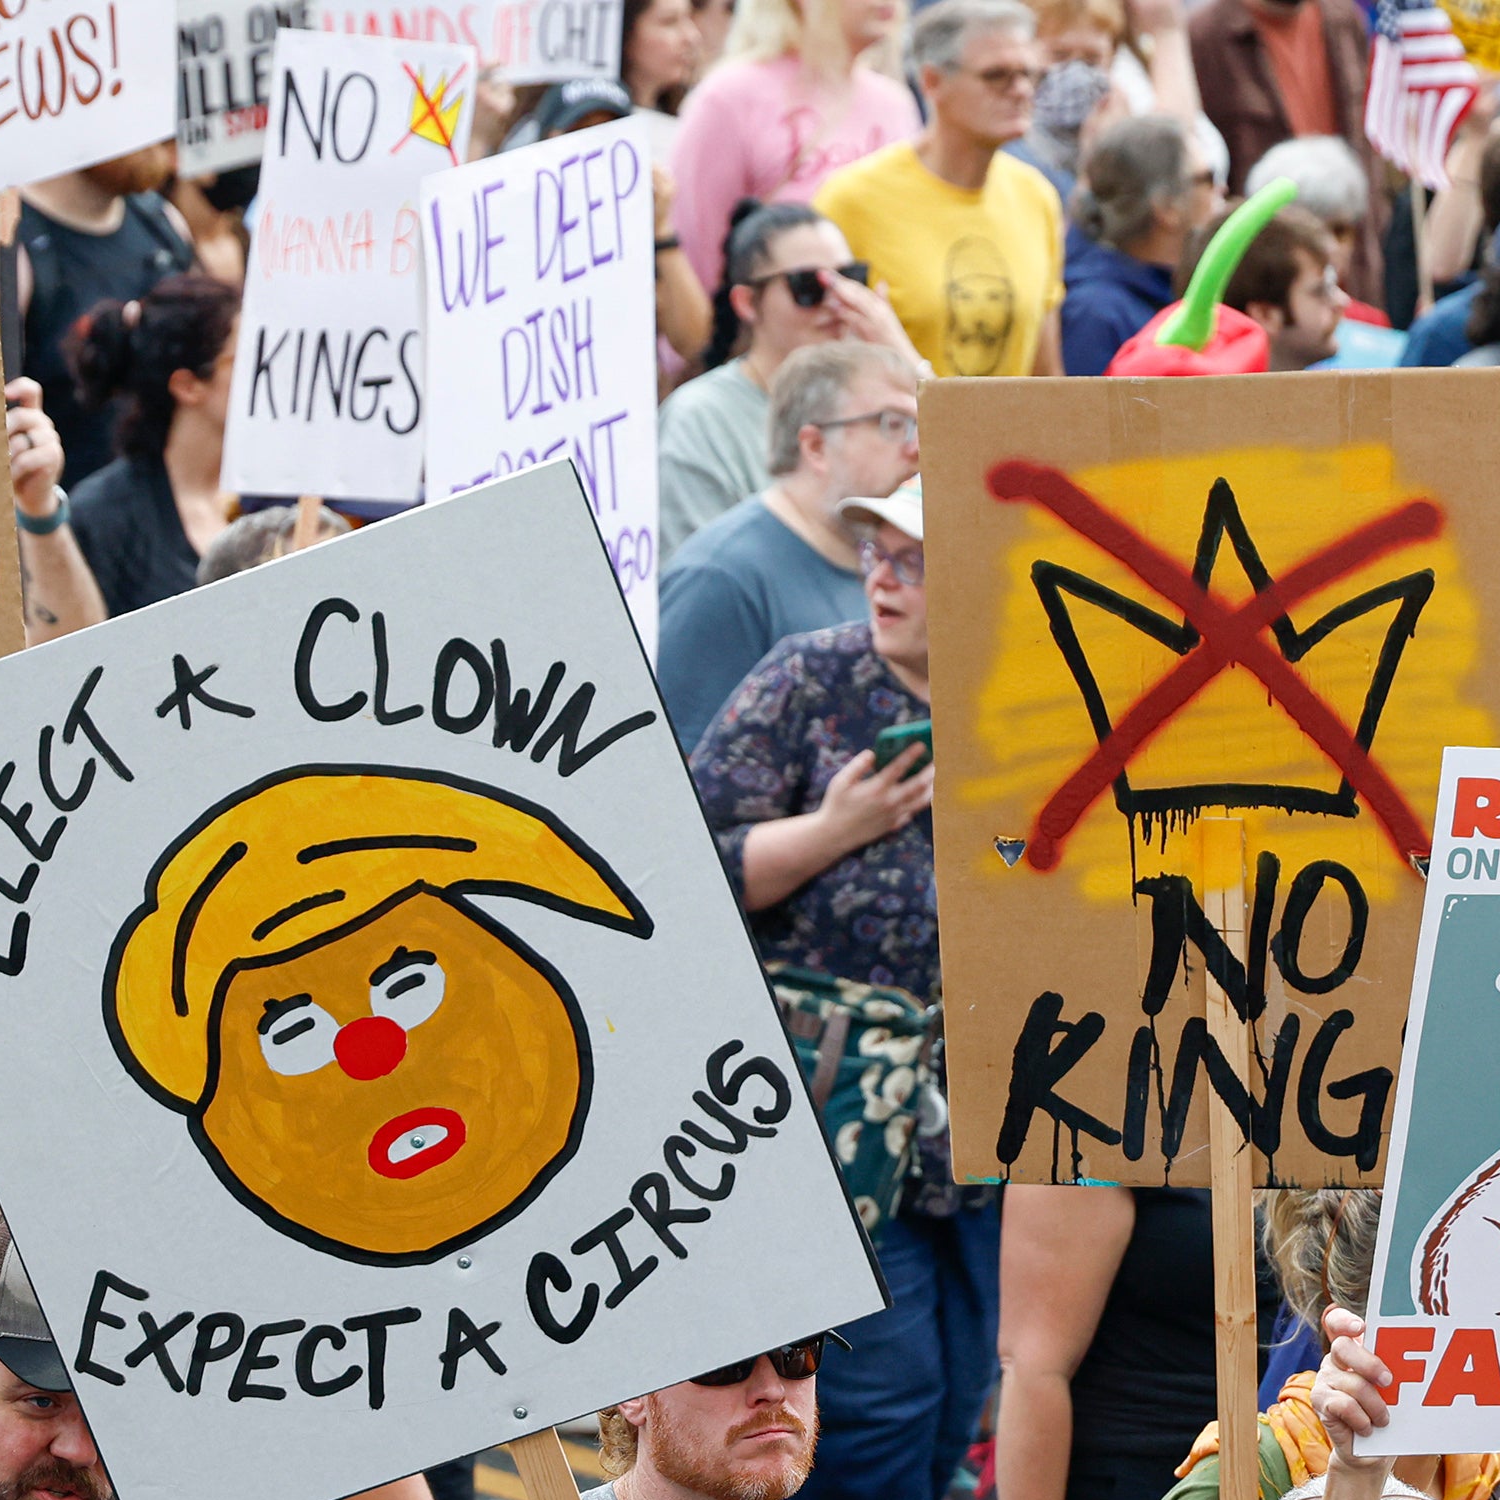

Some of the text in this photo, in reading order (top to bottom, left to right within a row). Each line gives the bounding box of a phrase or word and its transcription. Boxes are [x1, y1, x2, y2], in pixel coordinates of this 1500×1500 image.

[180, 49, 270, 119] ILLE
[280, 68, 378, 163] NO
[430, 181, 507, 313] WE
[534, 137, 641, 283] DEEP
[250, 327, 422, 436] KINGS
[501, 299, 598, 421] DISH
[156, 654, 255, 729] A
[295, 597, 657, 778] CLOWN
[1134, 851, 1369, 1024] NO
[996, 991, 1400, 1172] KING
[74, 1038, 794, 1410] EXPECT A CIRCUS
